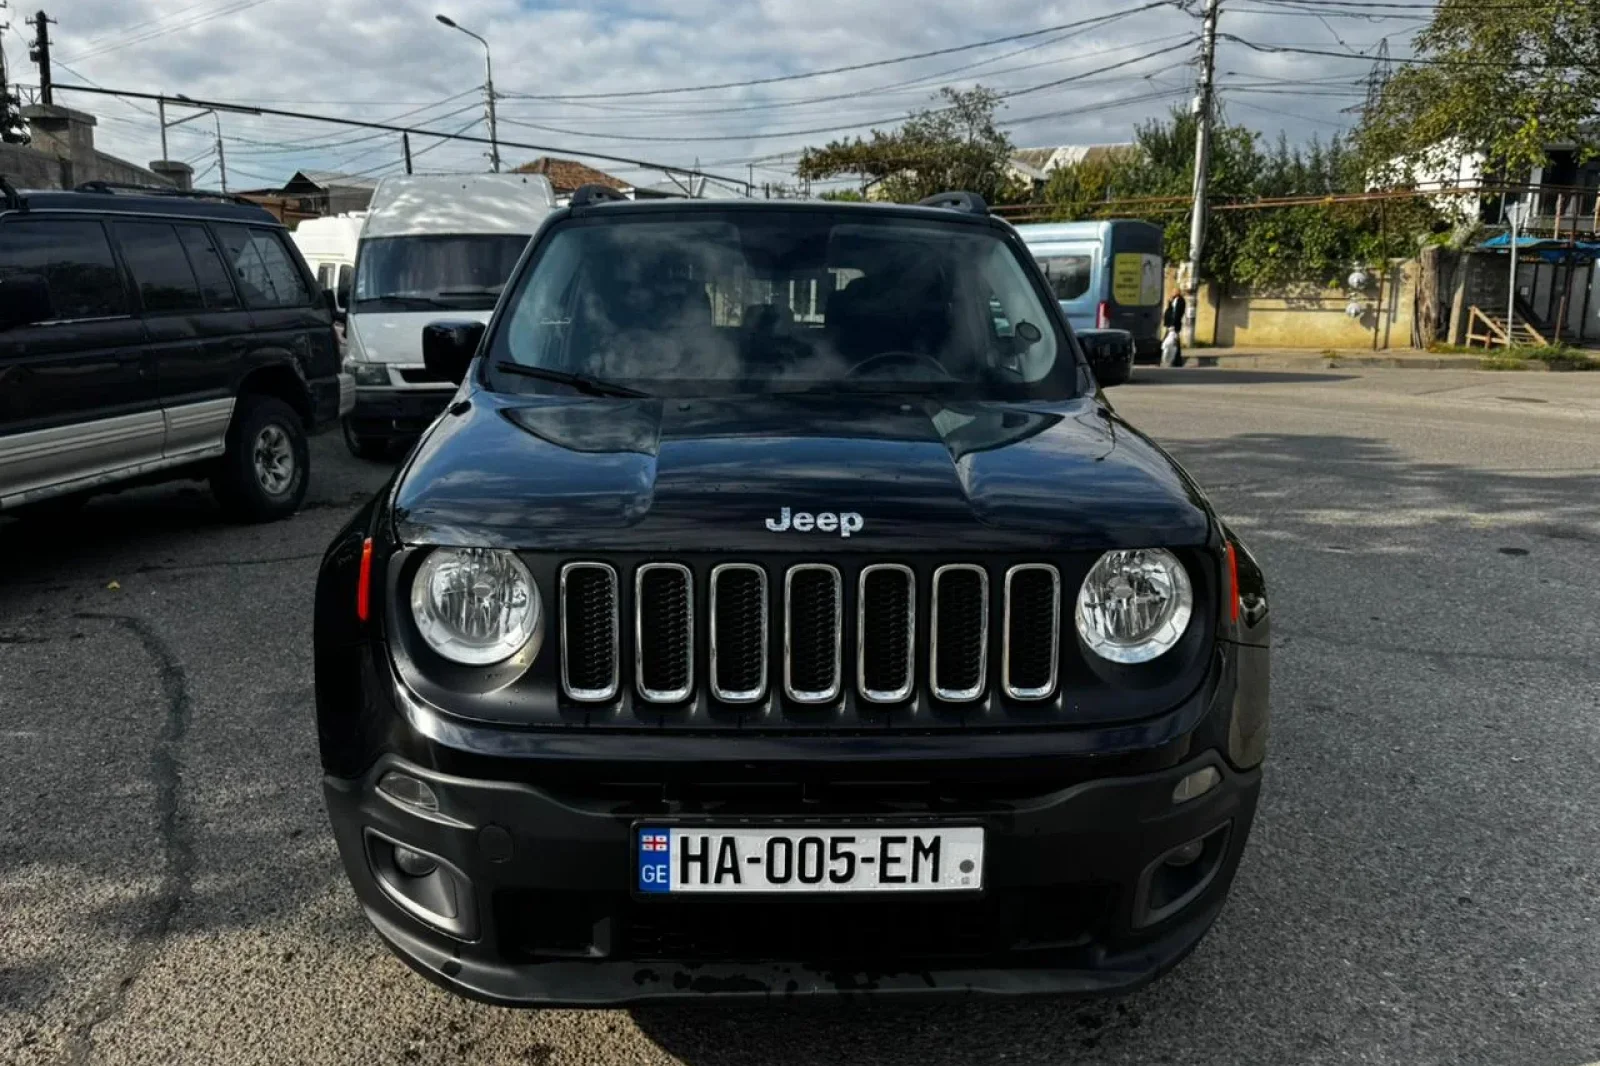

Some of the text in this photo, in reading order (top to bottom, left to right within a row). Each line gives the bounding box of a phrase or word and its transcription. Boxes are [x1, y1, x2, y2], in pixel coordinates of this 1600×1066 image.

[765, 507, 864, 537] Jeep
[641, 865, 668, 883] GE
[679, 836, 942, 884] HA-005-EM
